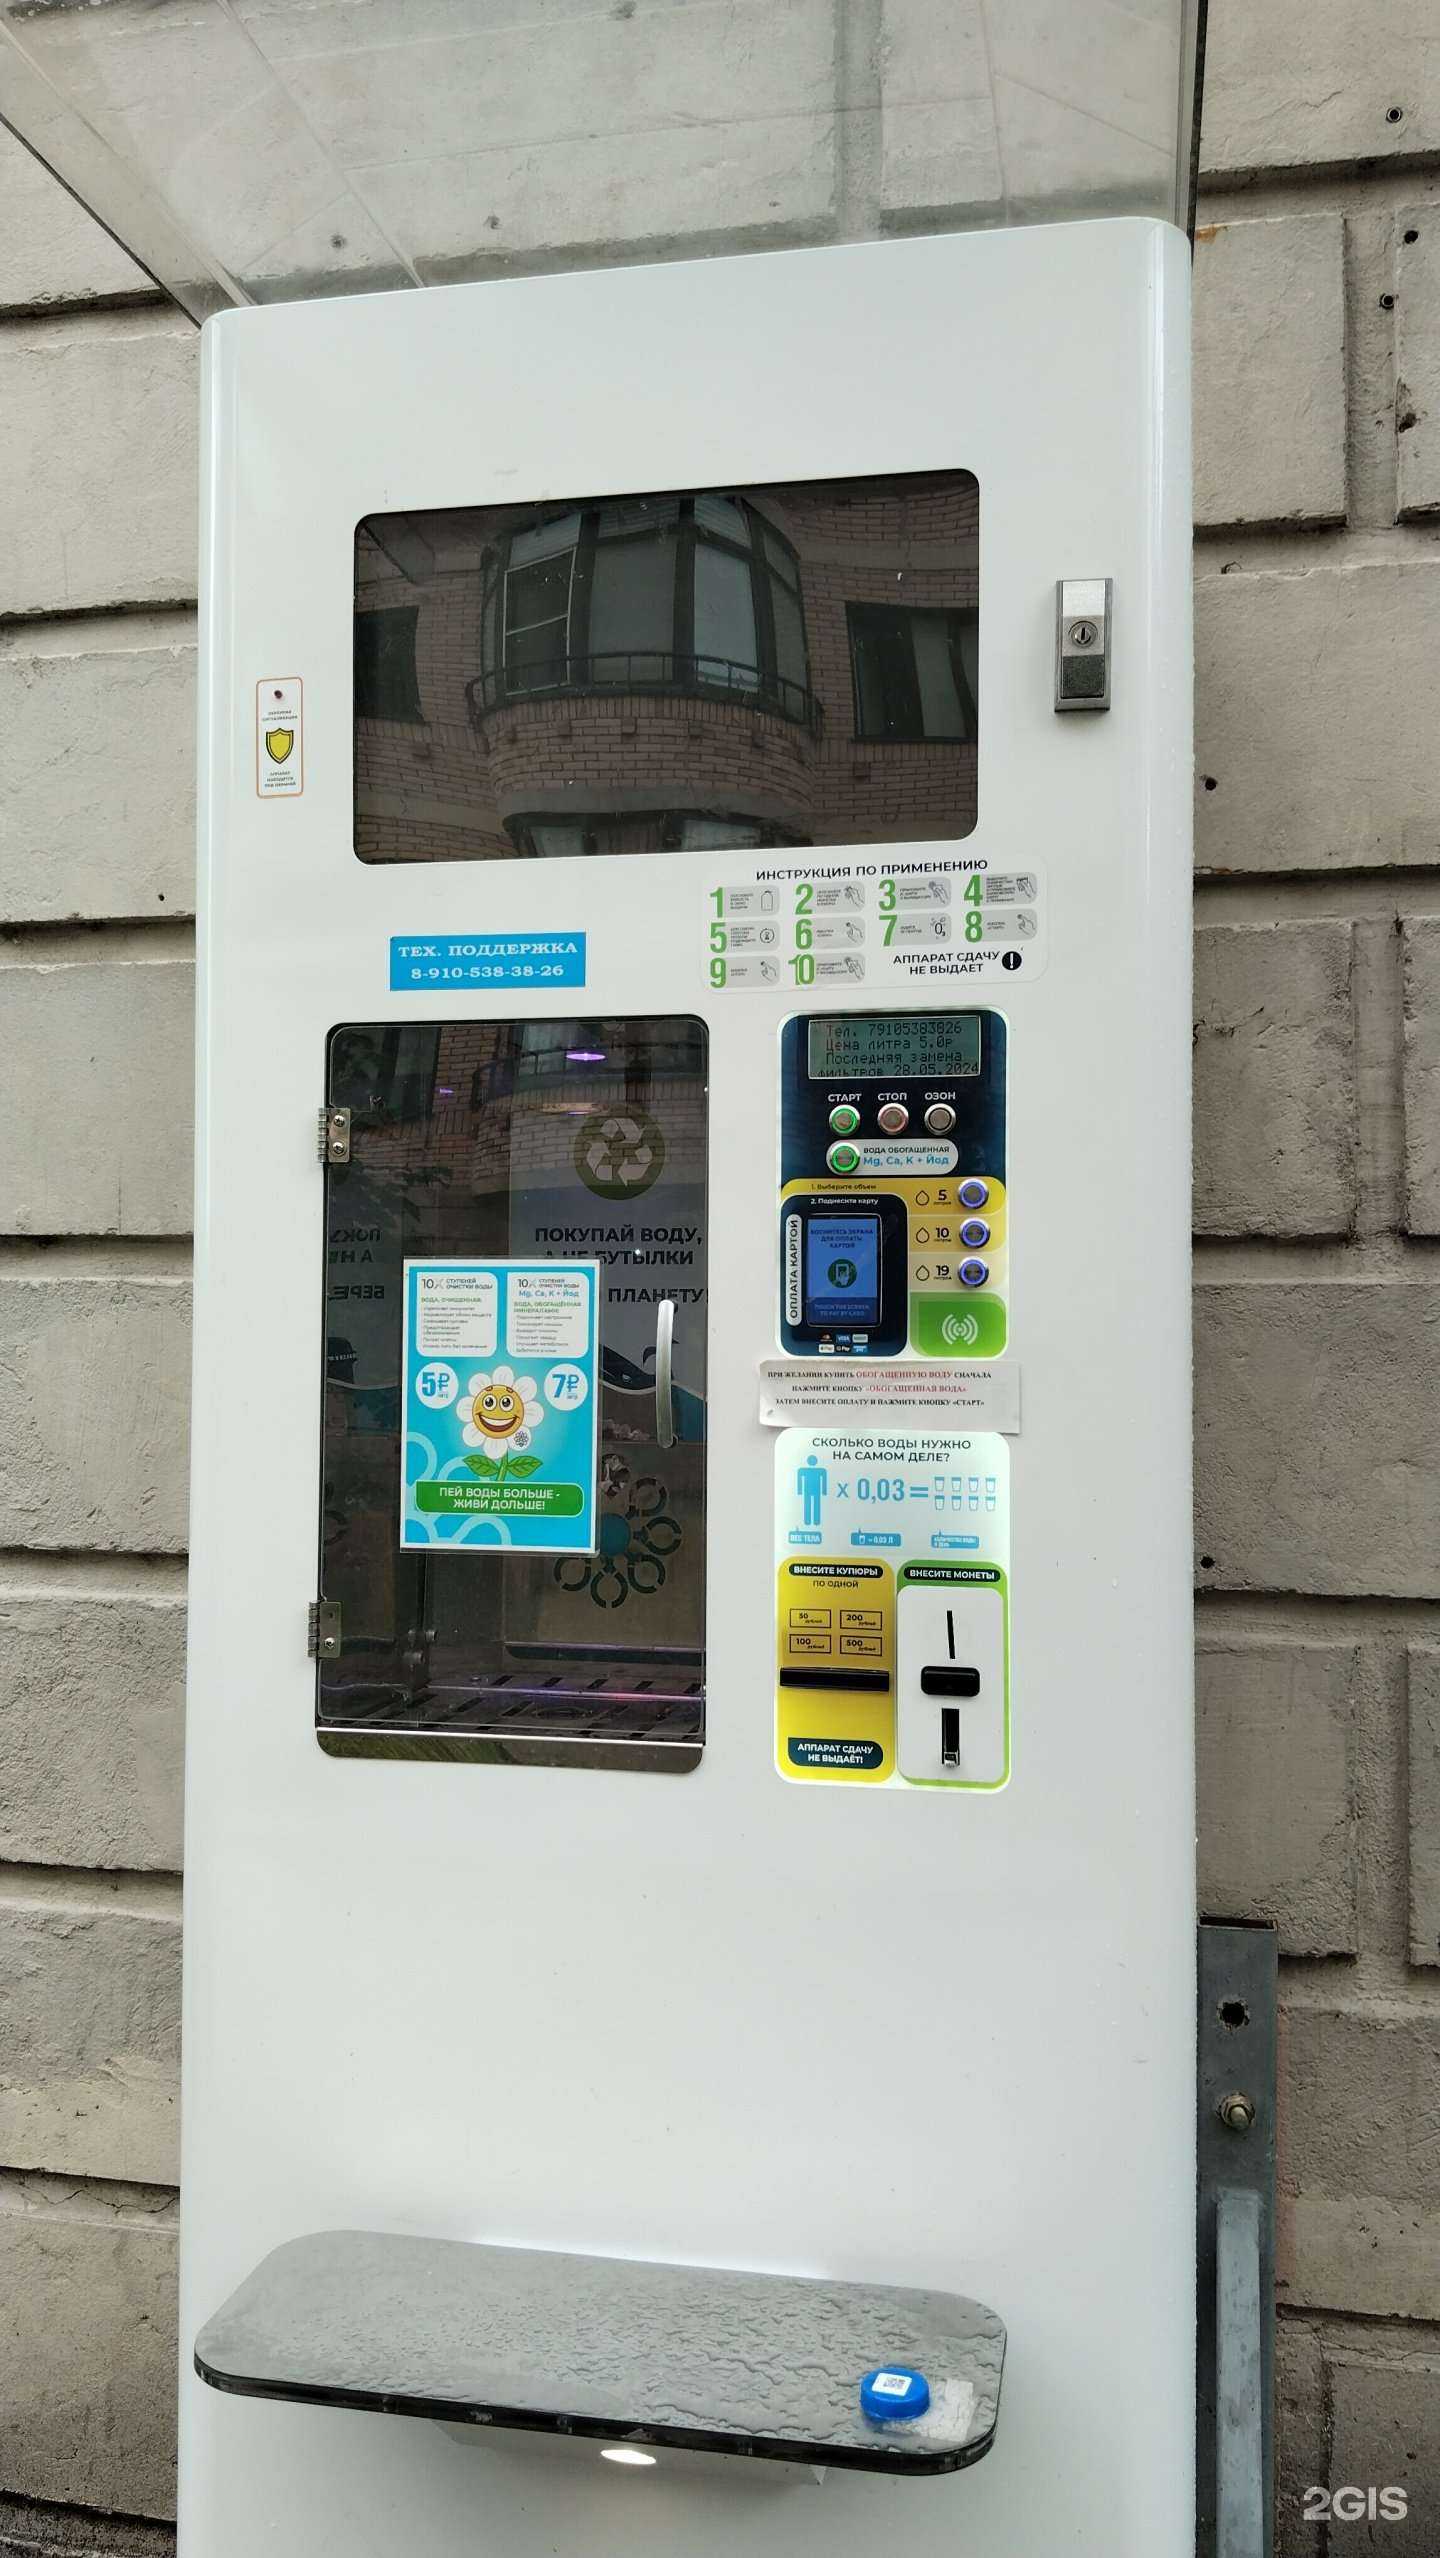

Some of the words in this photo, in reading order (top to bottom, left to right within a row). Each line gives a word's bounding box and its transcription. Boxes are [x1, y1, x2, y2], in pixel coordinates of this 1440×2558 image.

[756, 866, 850, 880] ИНСТРУКЦИЯ
[856, 865, 876, 876] ПО
[881, 860, 988, 874] ПРИМЕНЕНИЮ
[878, 879, 896, 911] 3
[964, 874, 983, 907] 4
[710, 887, 723, 918] 1
[795, 884, 813, 915] 2
[879, 915, 897, 947] 7
[965, 911, 983, 943] 8
[710, 922, 727, 954] 5
[795, 919, 812, 950] 6
[399, 946, 441, 957] ТЕХ.
[448, 942, 578, 957] ПОДДЕРЖКА
[893, 953, 953, 964] АППАРАТ
[957, 951, 1000, 962] СДАЧУ
[411, 965, 564, 980] 8-910-538-38-26
[710, 957, 727, 988] 9
[788, 954, 815, 985] 10
[910, 966, 926, 975] НЕ
[930, 963, 983, 975] ВЫДАЕТ
[827, 1025, 858, 1037] Тел.
[869, 1021, 962, 1036] 79105383826
[826, 1039, 860, 1053] Цена
[868, 1038, 911, 1050] литра
[826, 1052, 902, 1066] Последняя
[911, 1051, 962, 1063] замена
[828, 1094, 862, 1102] СТАРТ
[878, 1092, 907, 1101] СТОП
[925, 1092, 956, 1100] ОЗОН
[888, 1146, 950, 1154] ОБОГАЩЕННАЯ
[863, 1158, 882, 1167] Mg,
[926, 1154, 949, 1165] Йод
[817, 1183, 852, 1191] Выберите
[938, 1189, 947, 1201] 5
[535, 1224, 634, 1242] ПОКУПАЙ
[640, 1227, 702, 1245] ВОДУ,
[936, 1227, 949, 1238] 10
[788, 1219, 798, 1267] КАРТОЙ
[936, 1265, 949, 1275] 19
[789, 1270, 798, 1319] ОПЛАТА
[954, 1371, 991, 1379] СНАЧАЛА
[812, 1438, 874, 1448] СКОЛЬКО
[878, 1438, 917, 1450] ВОДЫ
[921, 1440, 971, 1449] НУЖНО
[832, 1451, 851, 1461] НА
[855, 1452, 904, 1461] САМОМ
[908, 1452, 950, 1463] ДЕЛЕ?
[439, 1486, 462, 1497] ПЕЙ
[466, 1487, 500, 1498] ВОДЫ
[504, 1488, 553, 1499] БОЛЬШЕ
[857, 1478, 905, 1504] 0,03
[453, 1499, 489, 1508] ЖИВИ
[491, 1499, 545, 1511] ДОЛЬШЕ!
[793, 1566, 834, 1575] ВНЕСИТЕ
[837, 1567, 878, 1576] КУПЮРЫ
[910, 1569, 951, 1578] ВНЕСИТЕ
[953, 1571, 995, 1580] МОНЕТЫ
[828, 1580, 858, 1589] ОДНОЙ
[798, 1743, 841, 1752] АППАРАТ
[843, 1745, 873, 1755] СДАЧУ
[808, 1753, 820, 1761] НЕ
[822, 1753, 863, 1764] ВЫДАЁТ!
